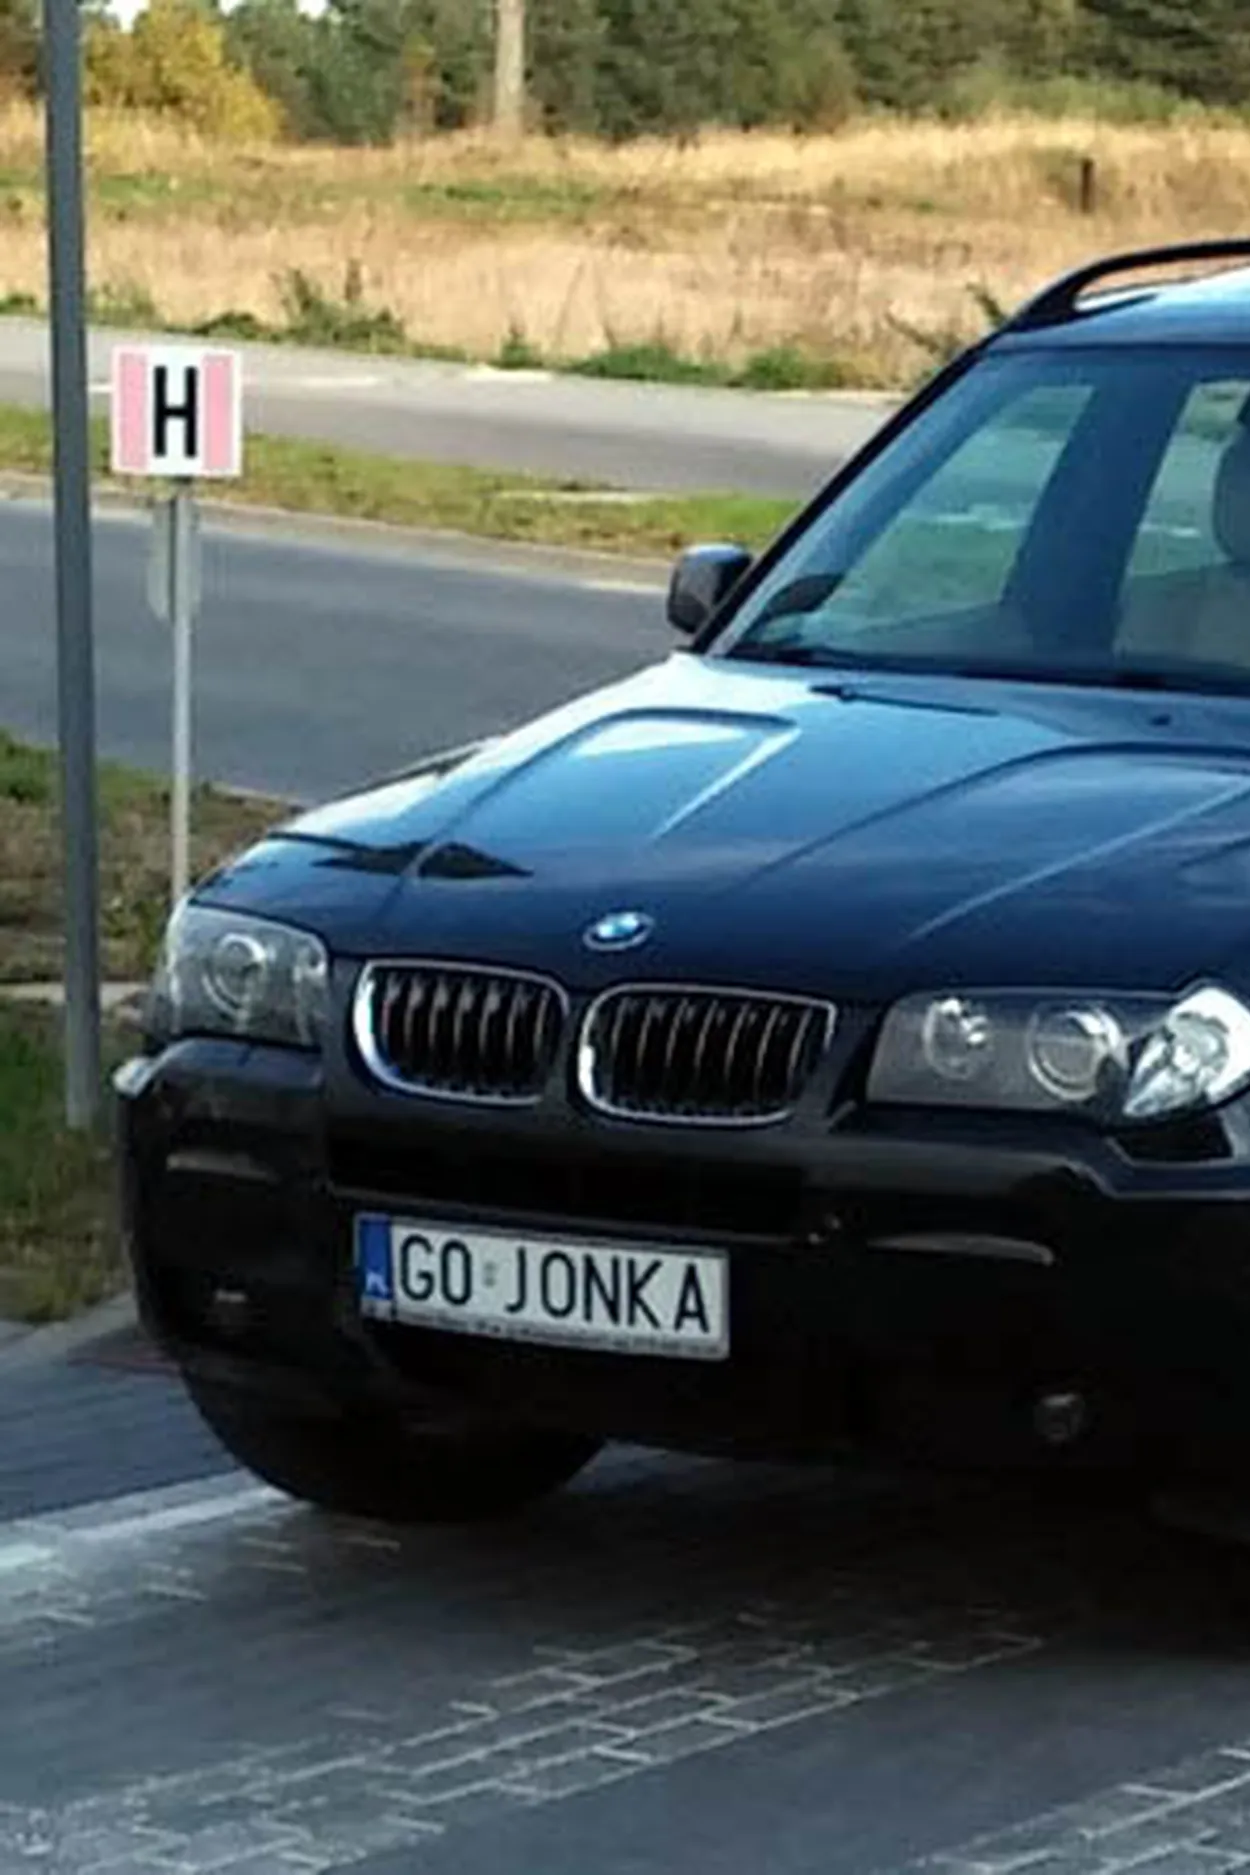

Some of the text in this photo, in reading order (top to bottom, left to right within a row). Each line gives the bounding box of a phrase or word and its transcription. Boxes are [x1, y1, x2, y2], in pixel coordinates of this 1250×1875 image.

[154, 365, 197, 458] H
[400, 1234, 473, 1305] GO
[504, 1246, 711, 1333] JONKA
